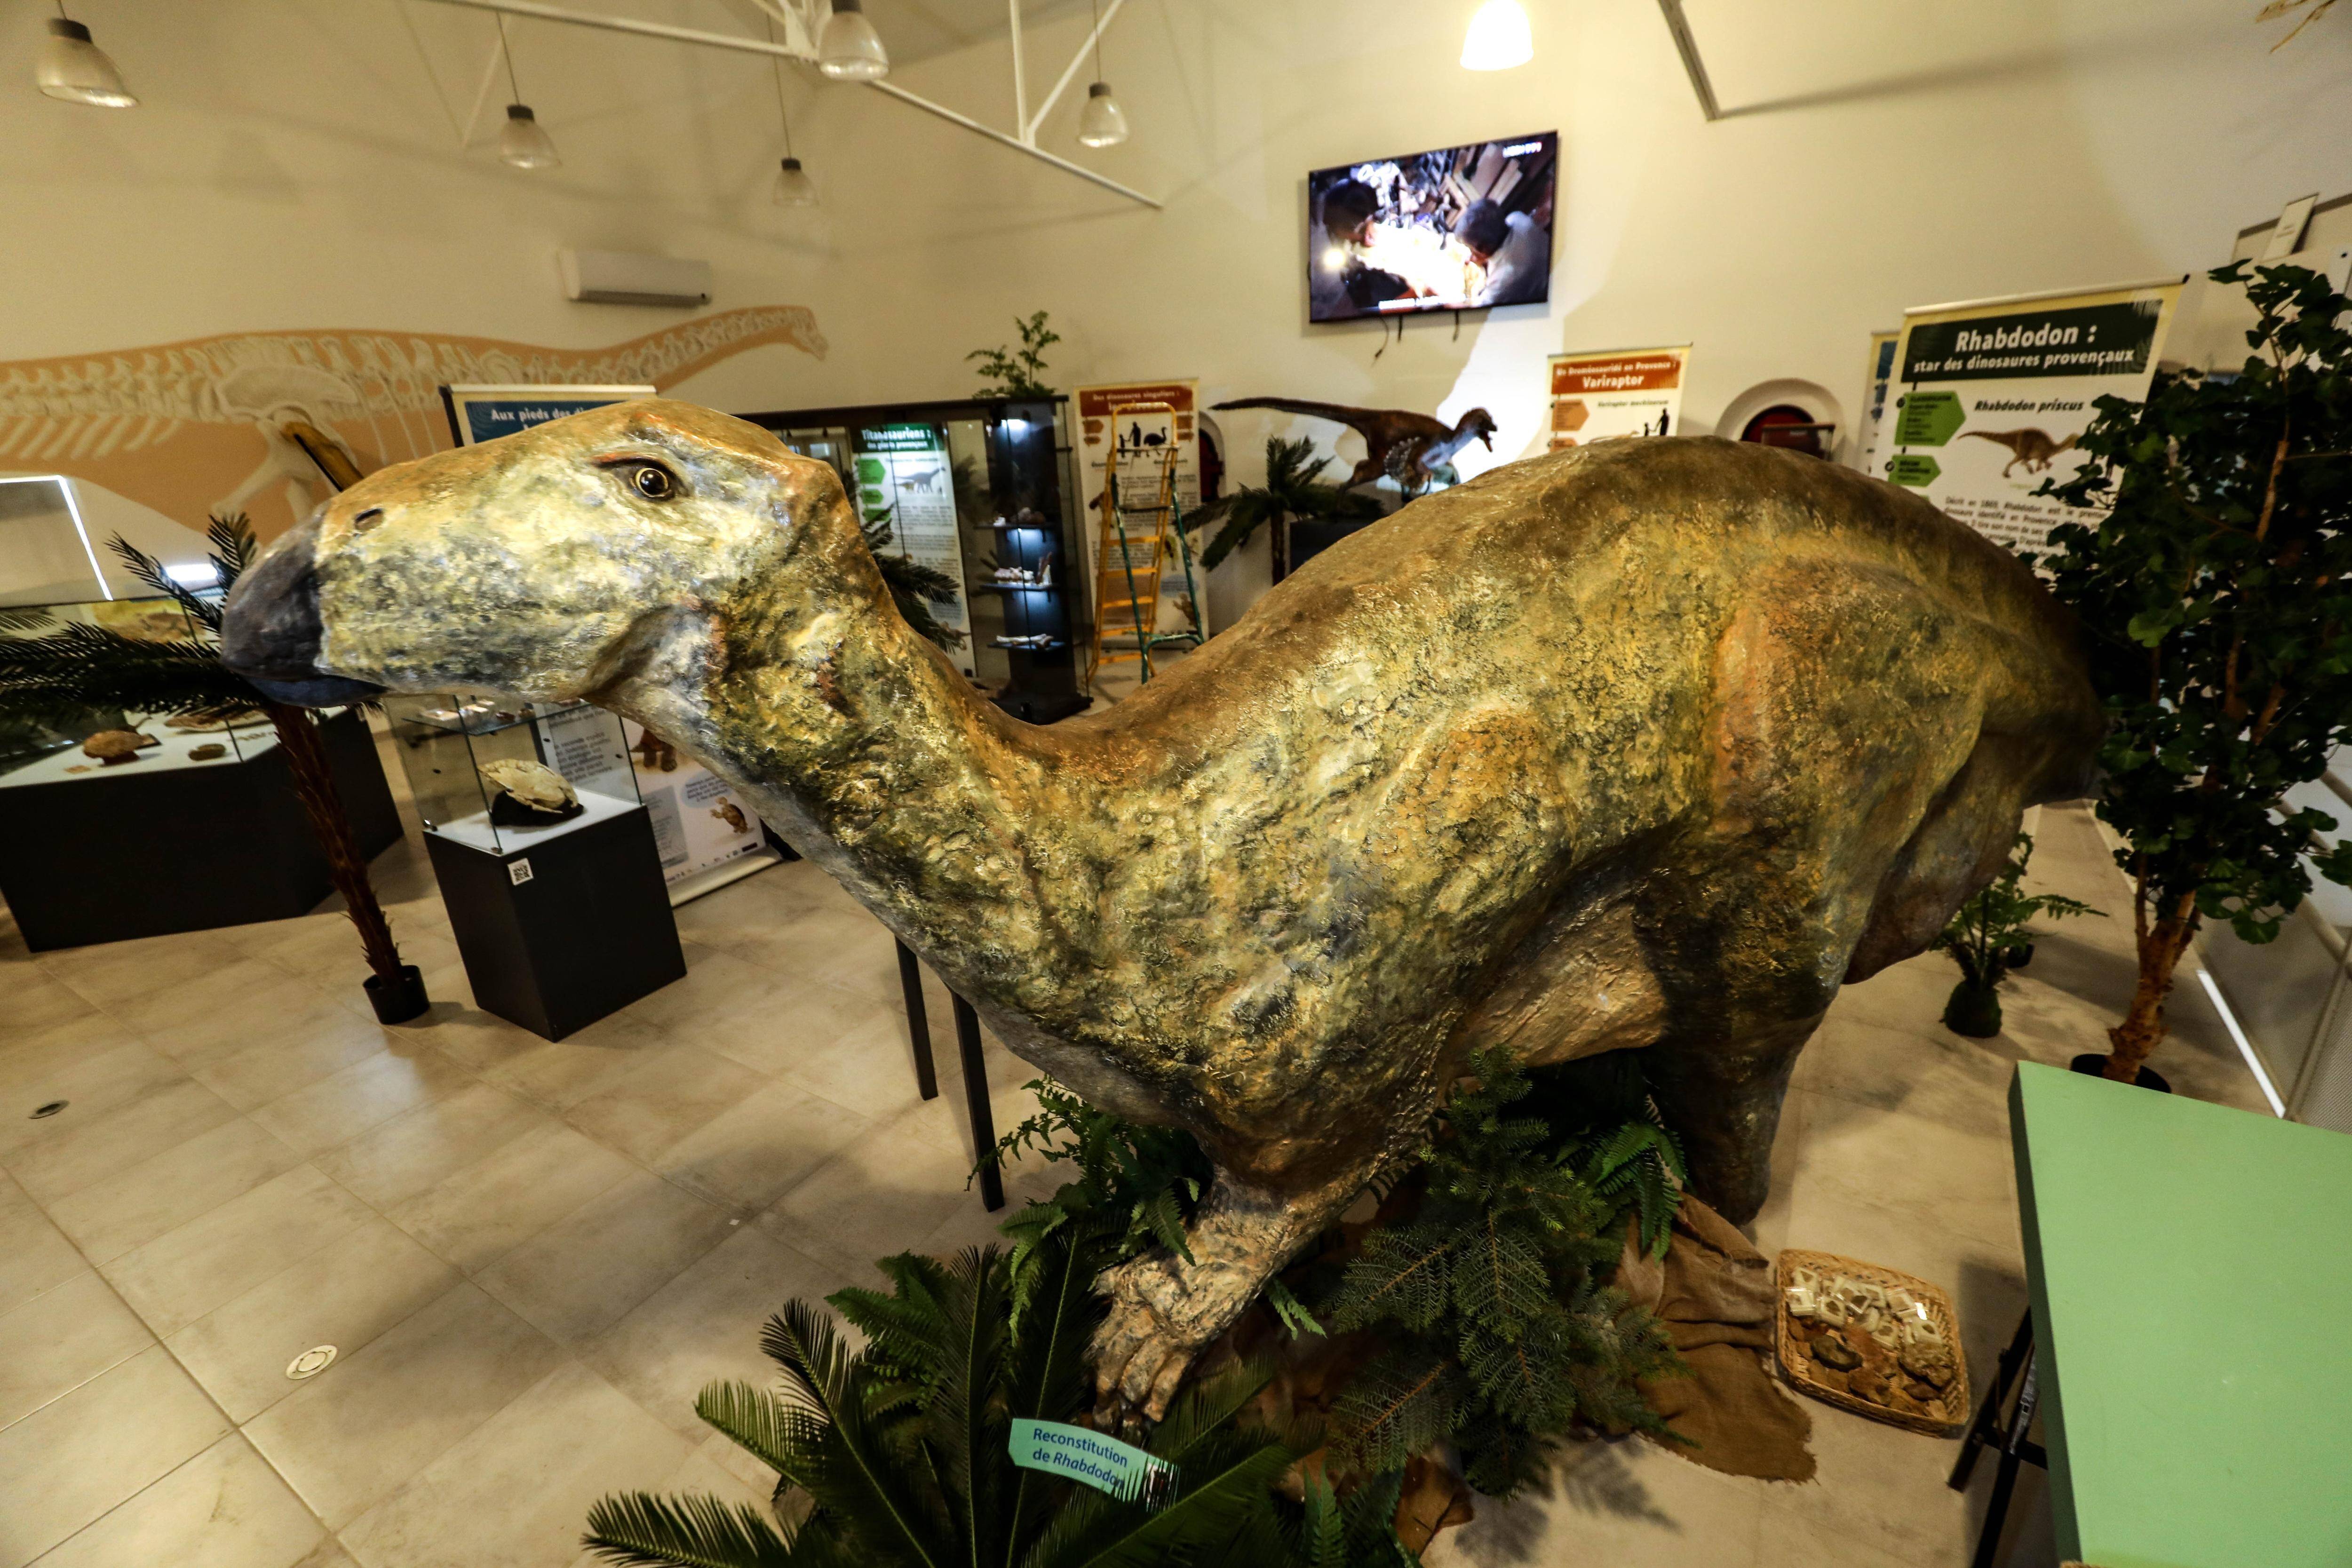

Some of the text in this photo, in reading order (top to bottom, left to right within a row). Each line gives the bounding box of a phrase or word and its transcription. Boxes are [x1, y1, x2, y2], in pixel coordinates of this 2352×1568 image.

[1955, 323, 2097, 352] Rhabdodon :
[1636, 361, 1670, 371] Provence
[1914, 349, 2135, 373] star des dinosaures provençaux
[1582, 374, 1645, 390] Variraptor
[491, 409, 514, 421] Aux
[518, 407, 549, 423] pieds
[552, 408, 570, 419] des
[1975, 398, 2084, 412] Rhabdodon priscus
[1033, 1428, 1128, 1468] Reconstitution
[1033, 1448, 1124, 1490] de Rhabdodon
